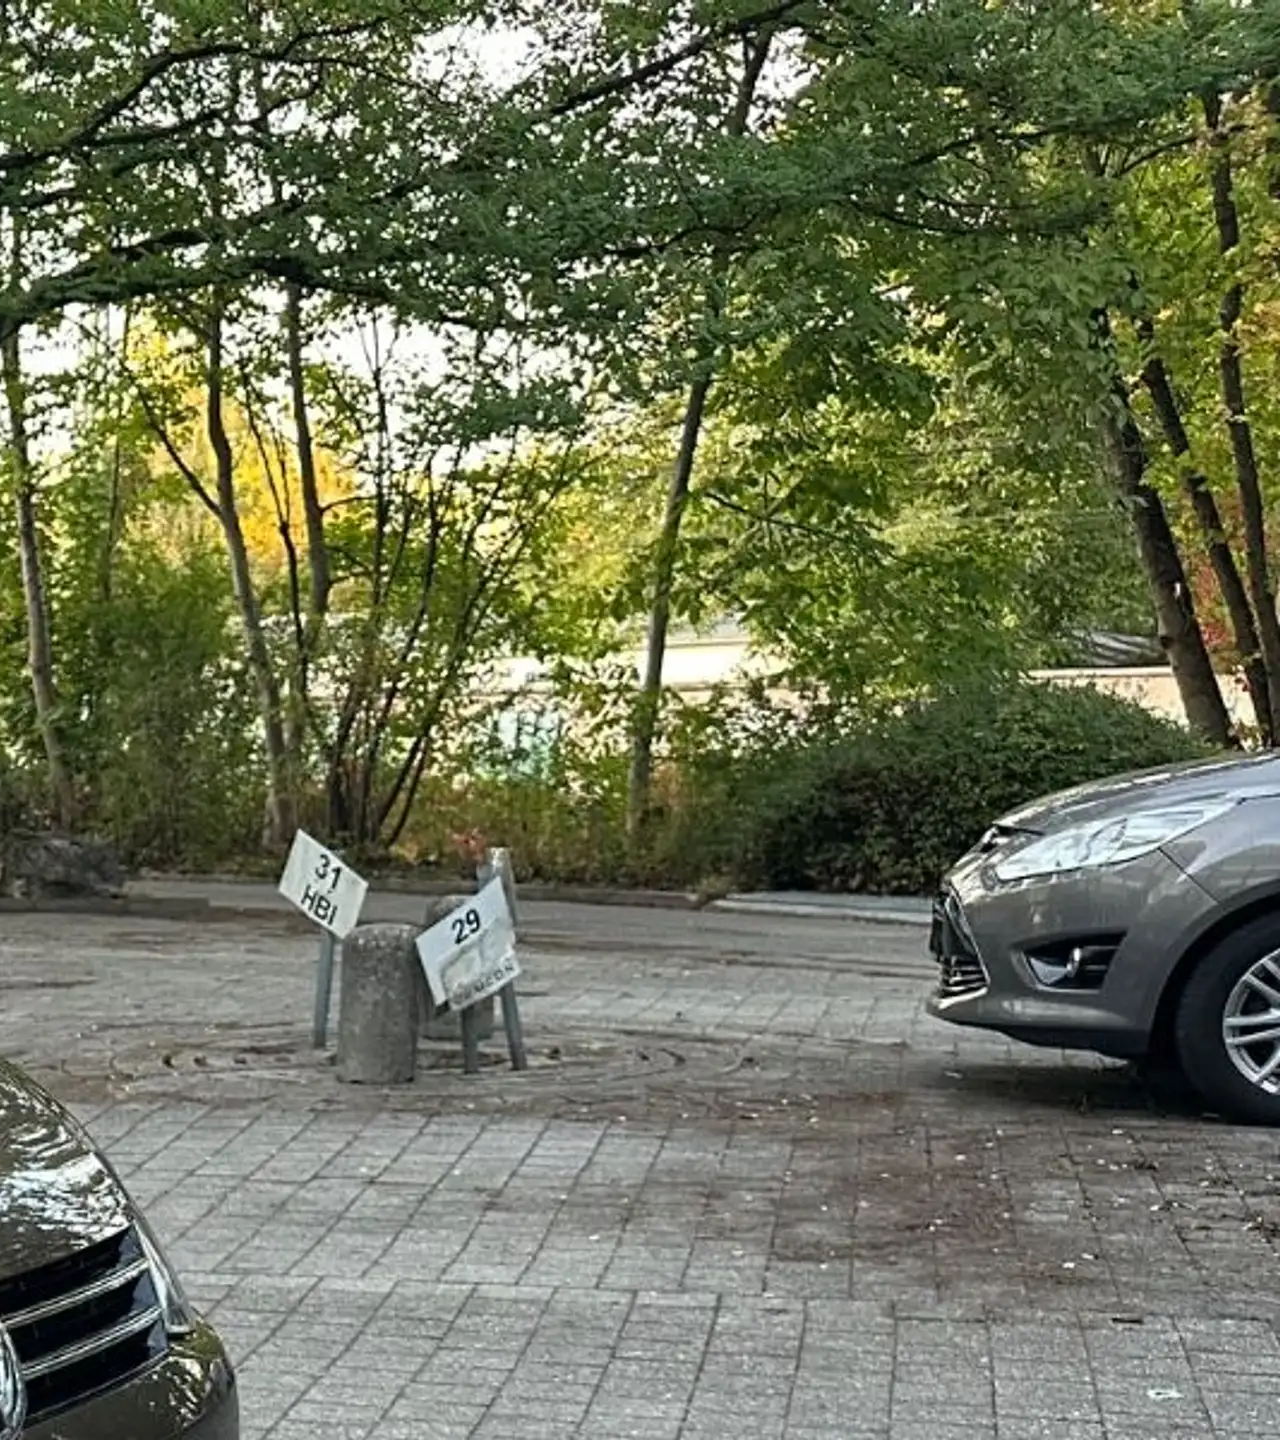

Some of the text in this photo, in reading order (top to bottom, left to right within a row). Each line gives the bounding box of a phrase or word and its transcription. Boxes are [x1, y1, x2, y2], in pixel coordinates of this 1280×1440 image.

[314, 853, 341, 890] 31
[301, 885, 338, 926] HBI
[452, 908, 480, 943] 29
